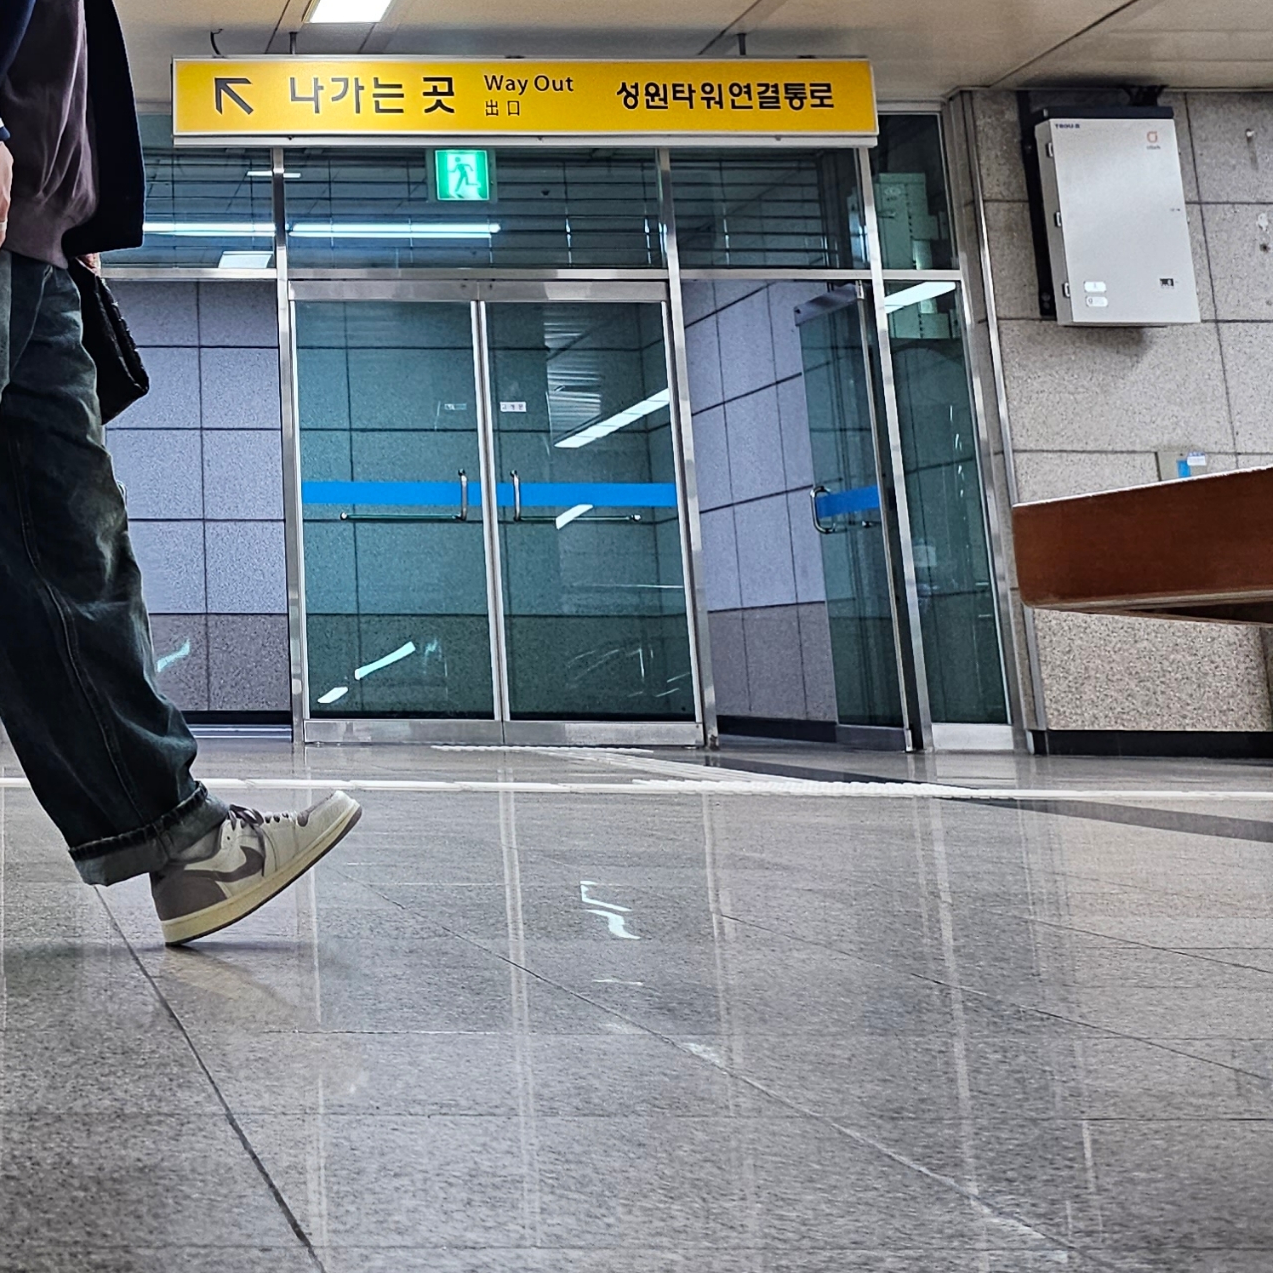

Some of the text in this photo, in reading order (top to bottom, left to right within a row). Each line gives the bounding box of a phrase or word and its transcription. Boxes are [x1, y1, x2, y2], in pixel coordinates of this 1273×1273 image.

[289, 76, 455, 114] 나가는 곳
[483, 74, 574, 96] Way Out
[616, 81, 835, 111] 성원타워연결통로
[485, 99, 520, 116] 出口
